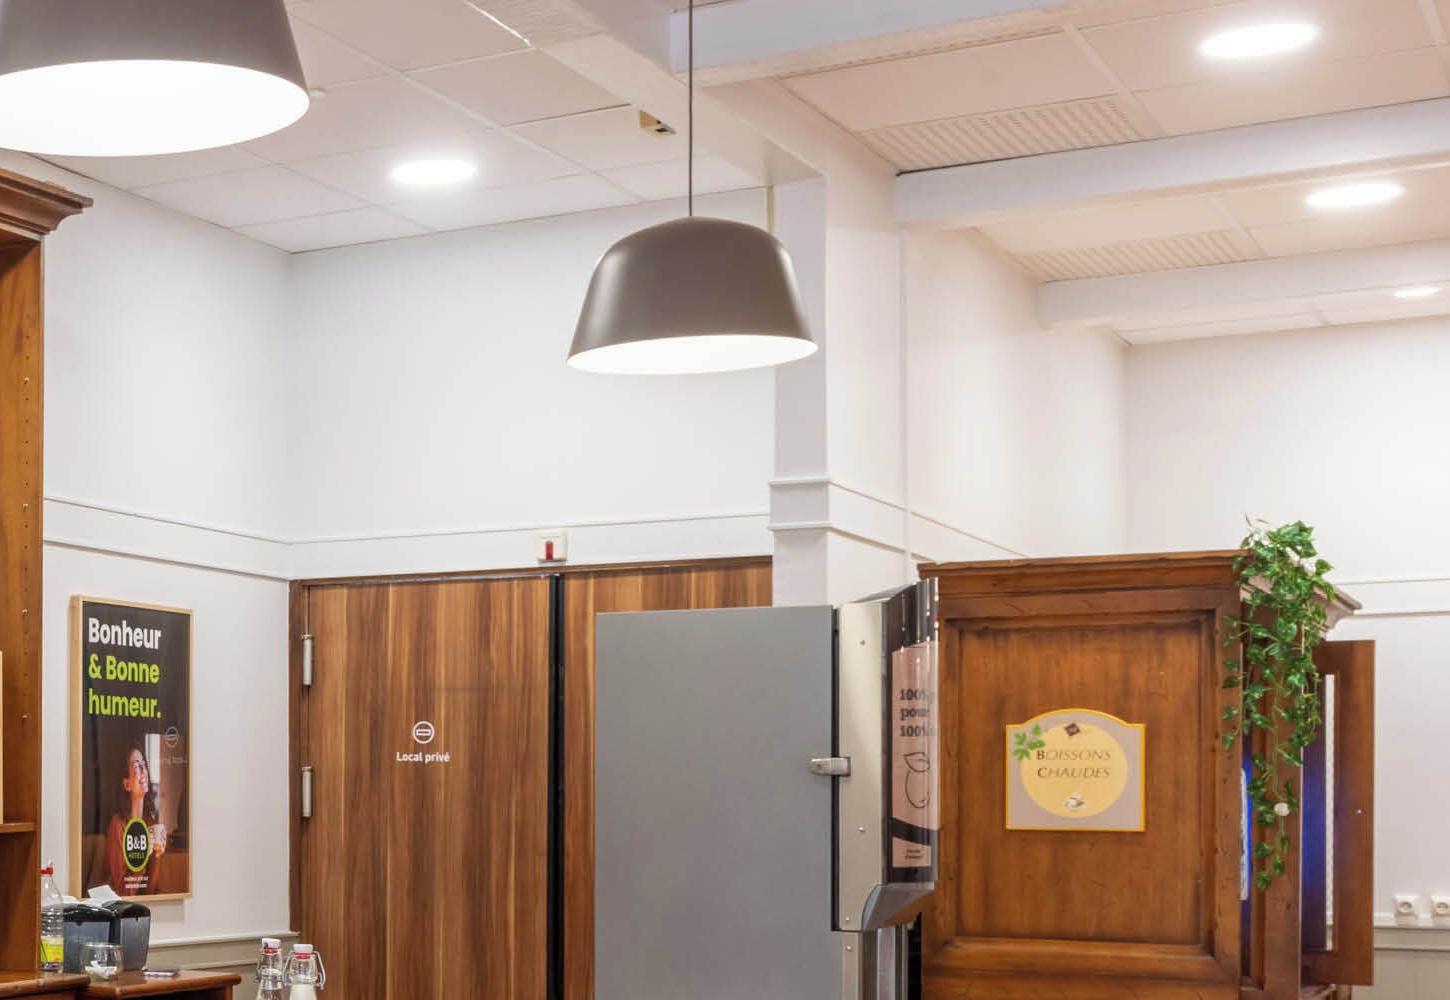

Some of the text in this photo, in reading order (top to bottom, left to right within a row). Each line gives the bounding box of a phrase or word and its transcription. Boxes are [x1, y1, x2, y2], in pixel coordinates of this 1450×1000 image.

[88, 617, 162, 650] Bonheur
[88, 653, 160, 684] & Bonne
[899, 687, 934, 701] 100
[88, 687, 161, 718] humeur.
[899, 724, 934, 738] 100
[396, 751, 451, 764] Local privé
[1036, 750, 1111, 761] BOISSONS
[1037, 767, 1111, 778] CHAUDES
[126, 834, 147, 851] B&B
